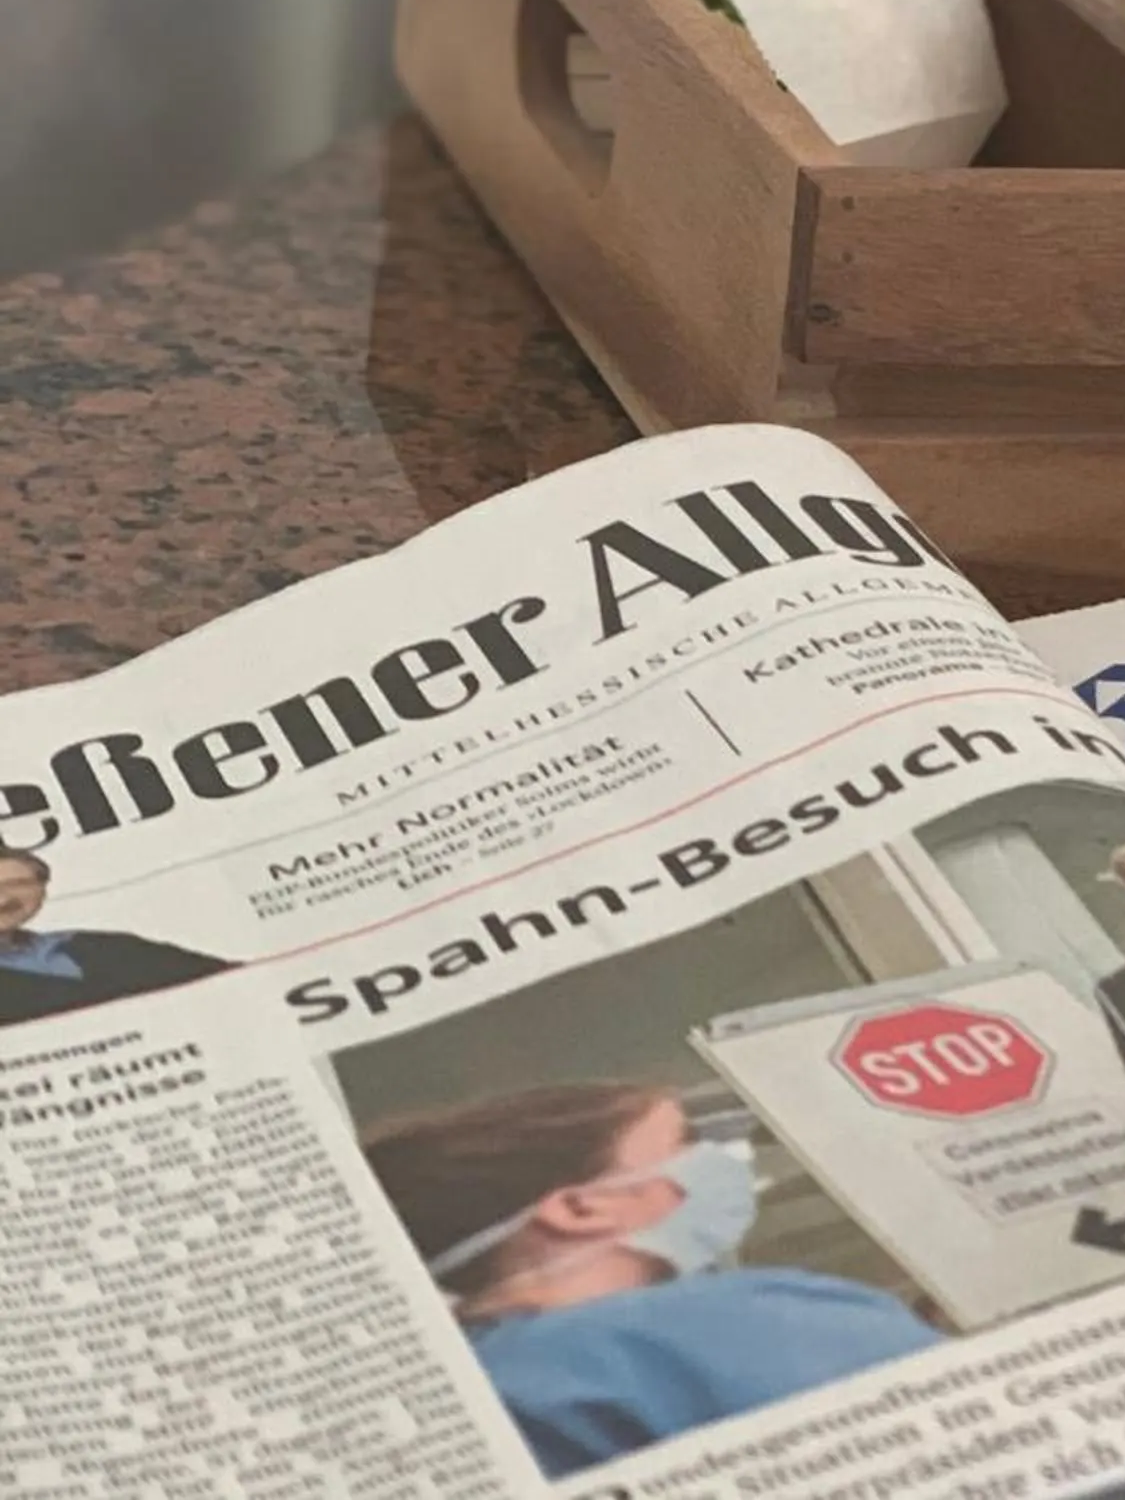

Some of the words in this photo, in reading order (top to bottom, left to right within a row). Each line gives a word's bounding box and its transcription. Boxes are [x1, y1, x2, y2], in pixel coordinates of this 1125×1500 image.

[743, 615, 964, 684] Kathedrale
[336, 612, 759, 806] MITTELHESSISCHE
[268, 832, 383, 881] Mehr
[396, 736, 624, 836] Normalität
[285, 723, 1017, 1024] Spahn-Besuch
[68, 1041, 203, 1090] räumt
[860, 1022, 1016, 1095] STOP
